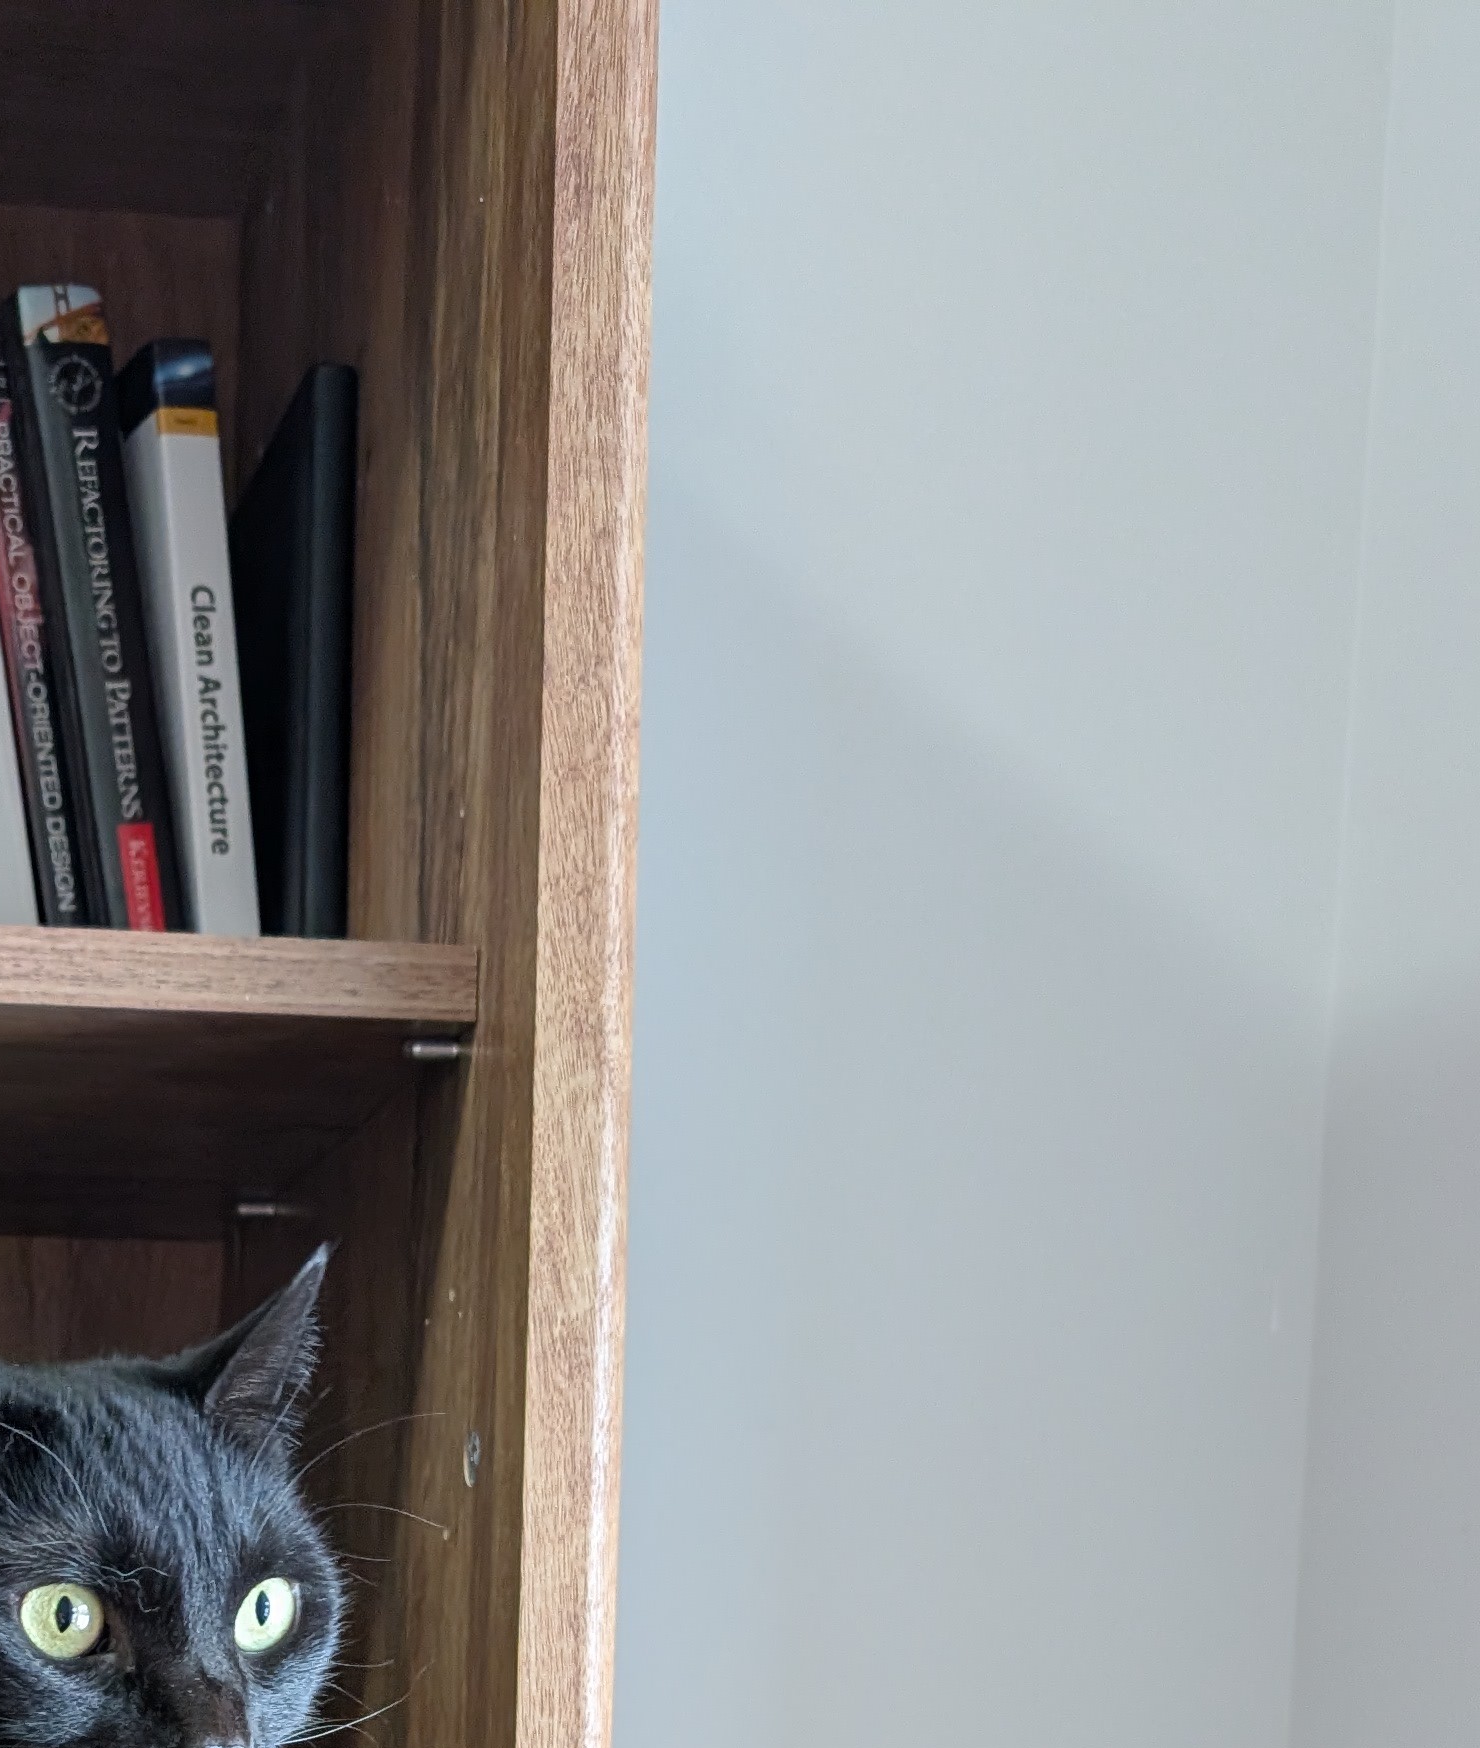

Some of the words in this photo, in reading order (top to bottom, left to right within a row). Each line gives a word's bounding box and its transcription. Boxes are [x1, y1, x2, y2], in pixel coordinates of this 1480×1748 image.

[73, 427, 117, 630] REFACTORING
[99, 634, 123, 673] TO
[191, 585, 216, 666] Clean
[13, 573, 62, 811] OBJECT-ORIENTED
[46, 816, 77, 912] DESIGN
[104, 679, 143, 819] PATTERNS
[197, 675, 229, 855] Architecture
